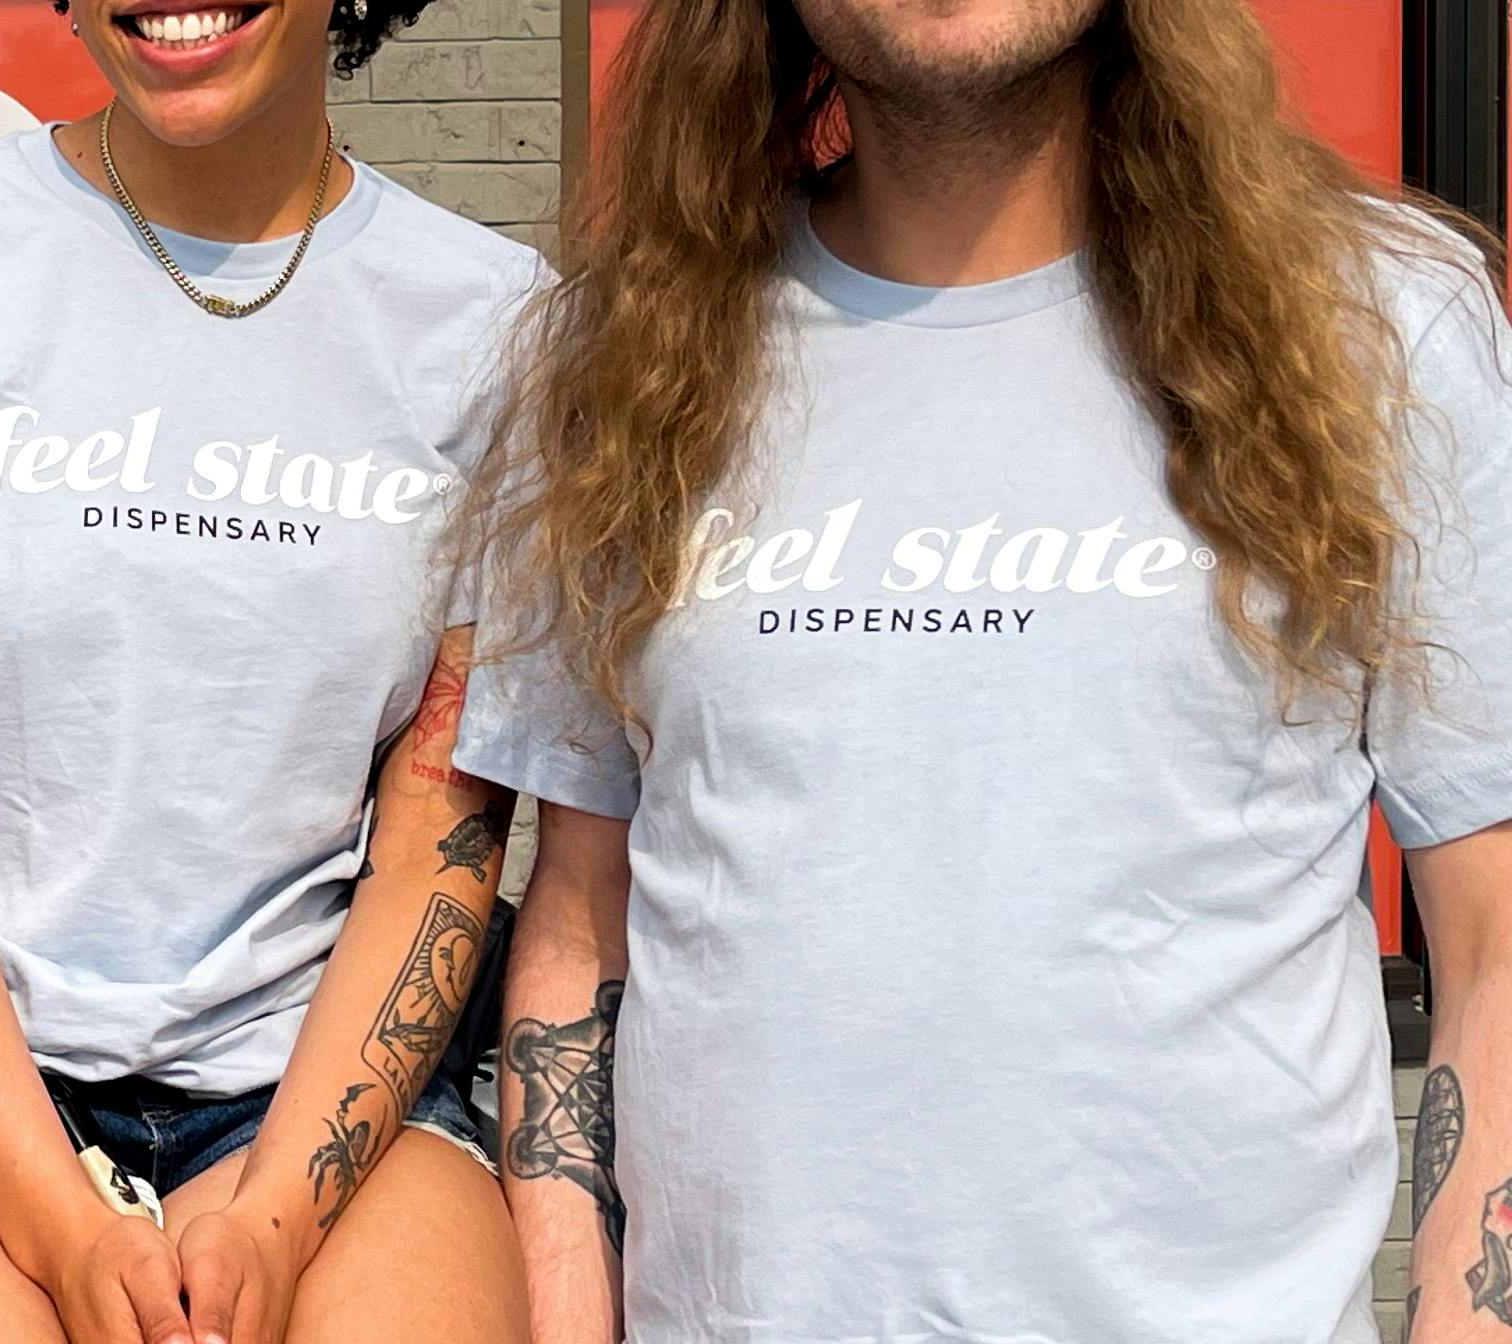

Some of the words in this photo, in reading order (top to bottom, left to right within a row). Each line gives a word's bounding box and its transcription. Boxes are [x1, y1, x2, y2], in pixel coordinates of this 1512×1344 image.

[83, 506, 322, 546] DISPENSARY
[665, 498, 863, 610] feel
[759, 608, 1035, 635] DISPENSARY
